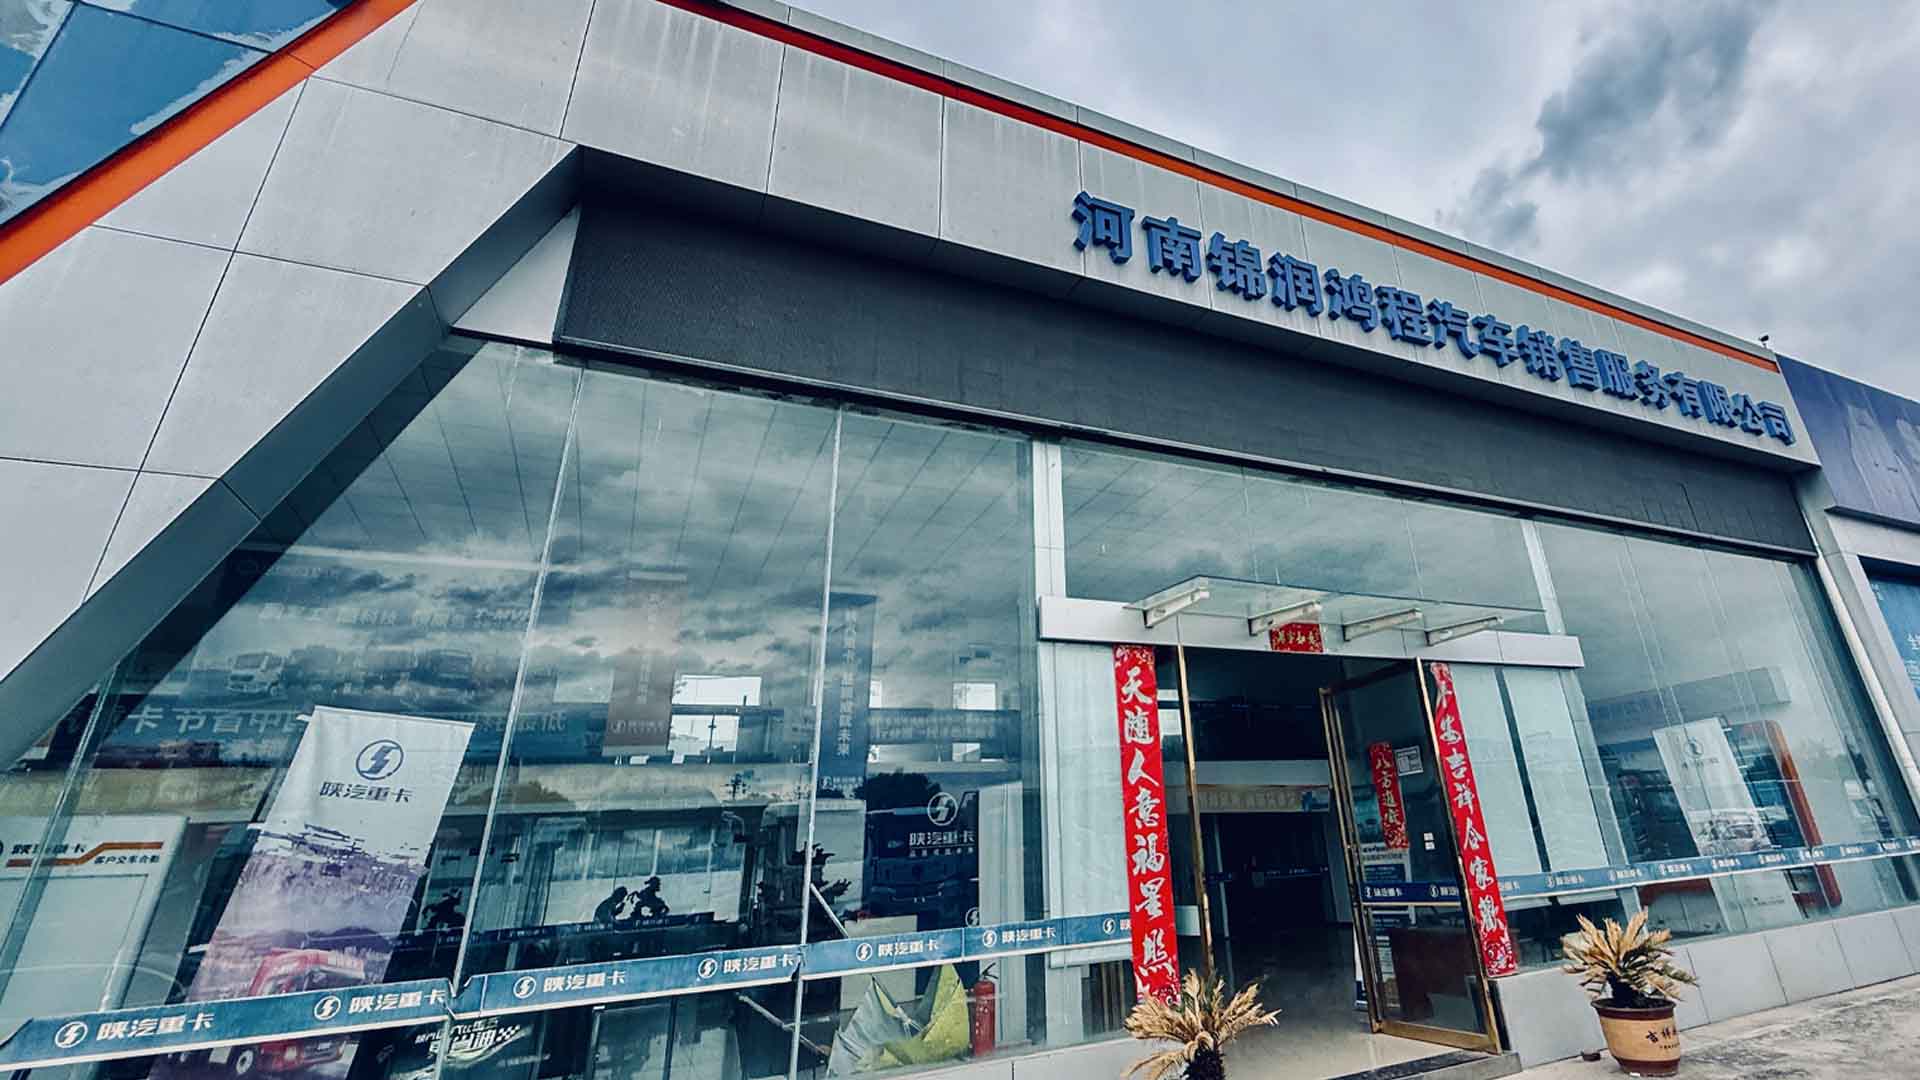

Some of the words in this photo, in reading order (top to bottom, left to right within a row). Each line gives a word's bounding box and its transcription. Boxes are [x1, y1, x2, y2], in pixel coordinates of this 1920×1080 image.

[1071, 190, 1796, 447] 河南锦润鸿程汽车销售服务有限公司
[319, 781, 413, 803] 陕汽重卡
[908, 831, 976, 846] 陕汽重卡
[1001, 927, 1057, 944] 陕汽重卡
[877, 938, 940, 957] 陕汽重卡
[723, 952, 797, 975] 陕汽重卡
[543, 970, 627, 993] 陕汽重卡
[348, 988, 447, 1013] 陕汽重卡
[95, 1012, 215, 1041] 陕汽重卡
